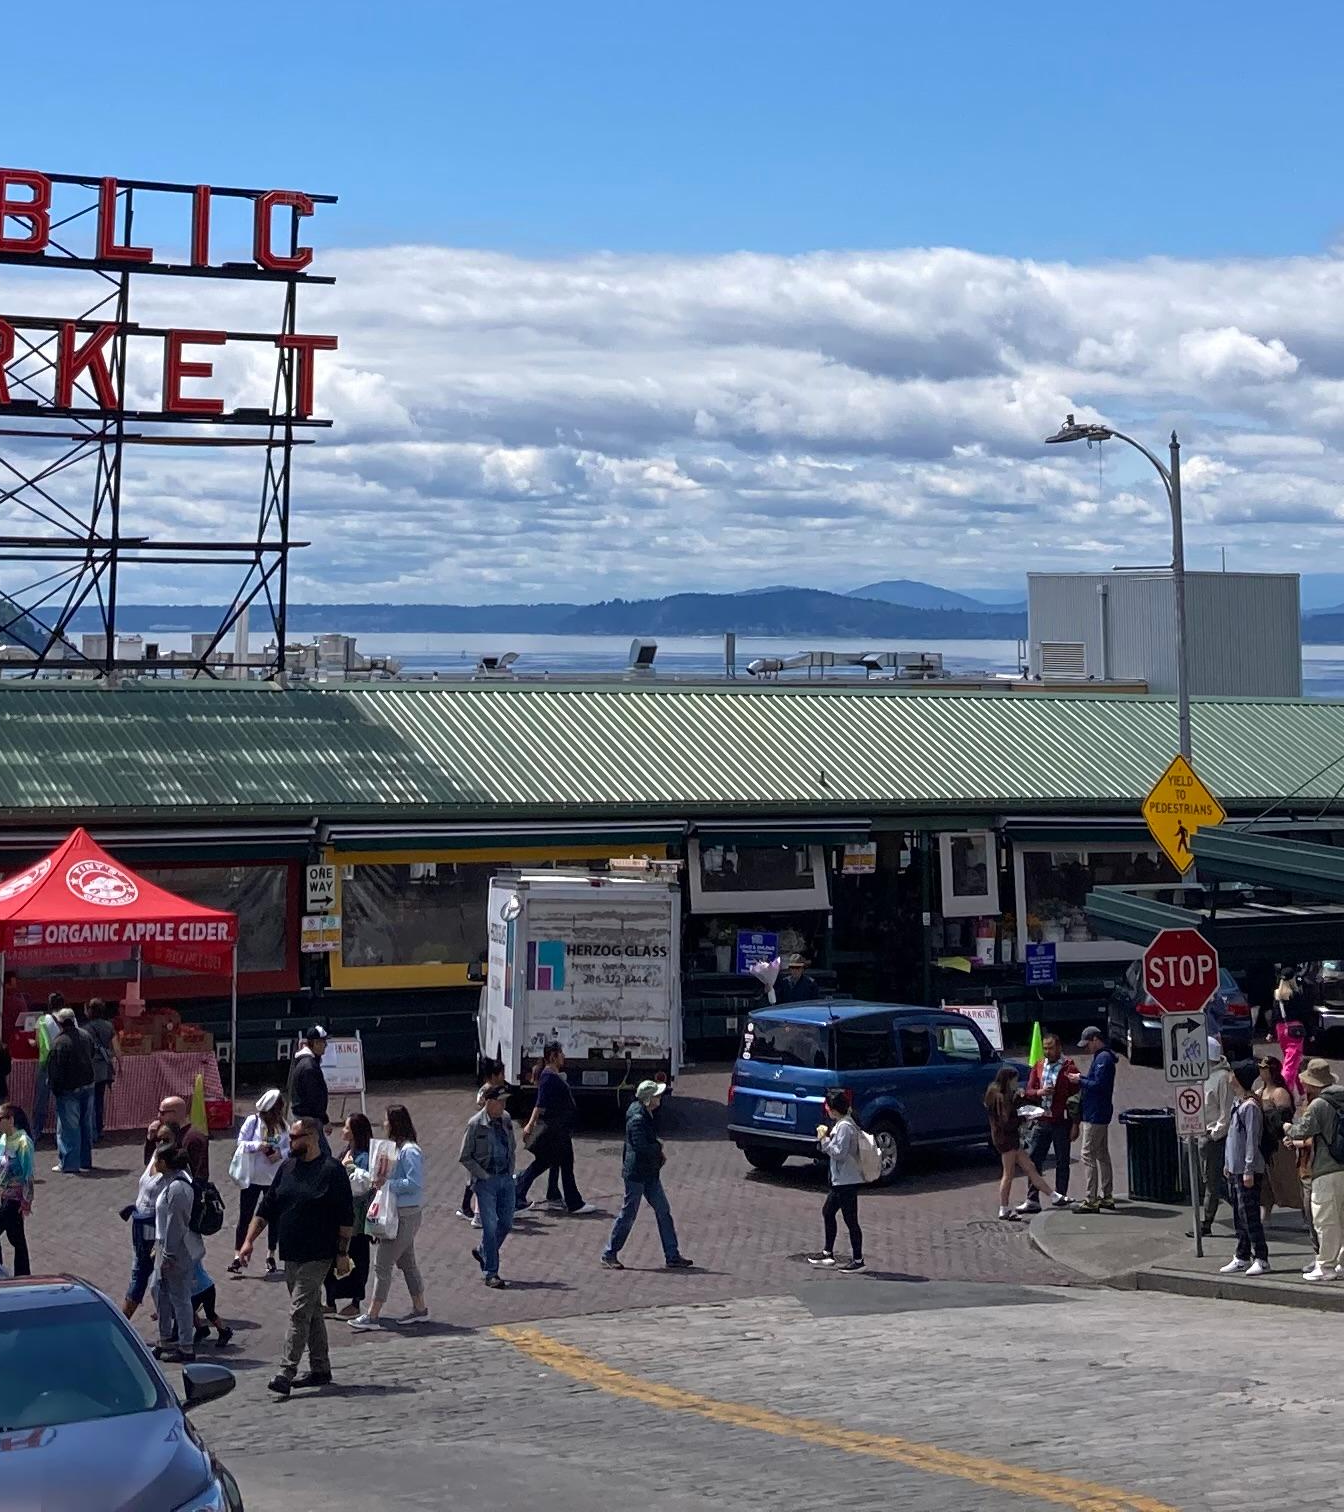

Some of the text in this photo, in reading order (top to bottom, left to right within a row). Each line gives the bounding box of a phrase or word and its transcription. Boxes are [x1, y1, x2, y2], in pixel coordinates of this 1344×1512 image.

[1167, 775, 1194, 787] YIELD
[1176, 789, 1186, 800] TO
[1149, 801, 1213, 816] PEDESTRIANS
[74, 860, 121, 877] TINY'S
[309, 867, 333, 880] ONE
[309, 881, 333, 892] WAY
[44, 922, 229, 944] ORGANIC APPLE CIDER
[566, 944, 667, 958] HERZOG GLASS
[1149, 954, 1213, 988] STOP
[1169, 1062, 1206, 1078] ONLY
